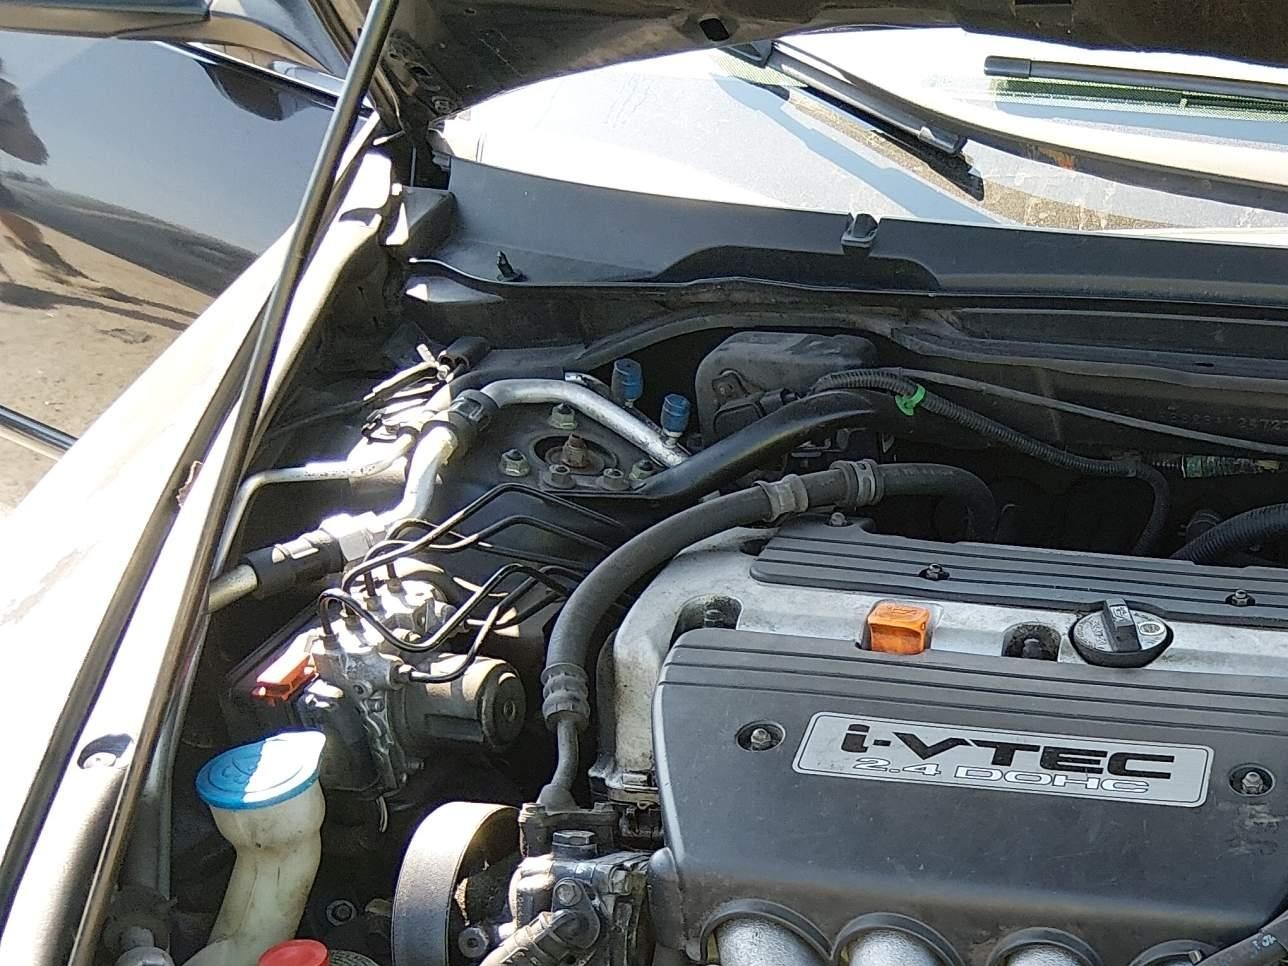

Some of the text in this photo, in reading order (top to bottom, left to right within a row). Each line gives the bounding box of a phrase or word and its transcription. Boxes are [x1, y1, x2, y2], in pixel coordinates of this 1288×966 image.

[841, 723, 1175, 779] i-VTEC
[852, 756, 1149, 793] 2.4 DOHC
